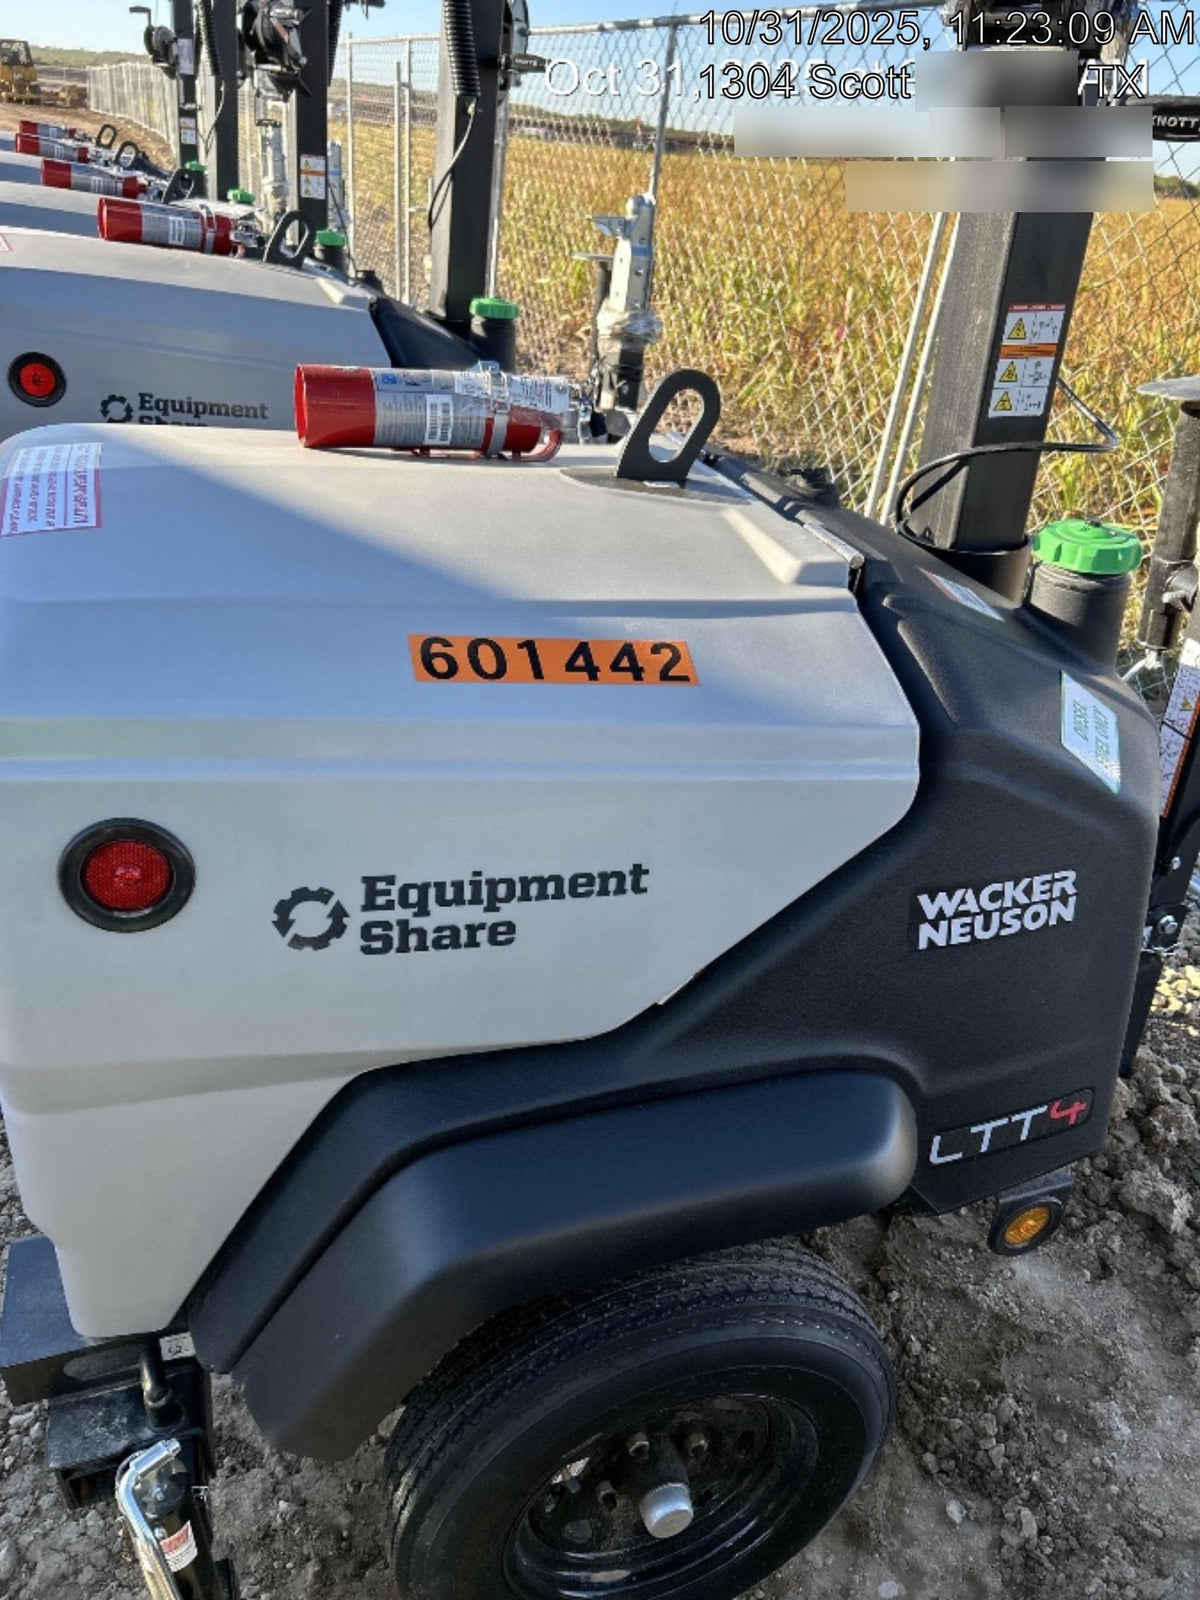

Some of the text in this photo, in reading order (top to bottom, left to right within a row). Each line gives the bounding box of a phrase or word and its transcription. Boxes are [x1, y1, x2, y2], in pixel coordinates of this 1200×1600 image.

[138, 392, 268, 420] Equipment
[420, 636, 690, 682] 601442
[361, 863, 649, 917] Equipment
[917, 869, 1078, 920] WACKER
[360, 919, 516, 955] Share
[918, 895, 1077, 950] NEUSON
[929, 1100, 1087, 1165] LTT4
